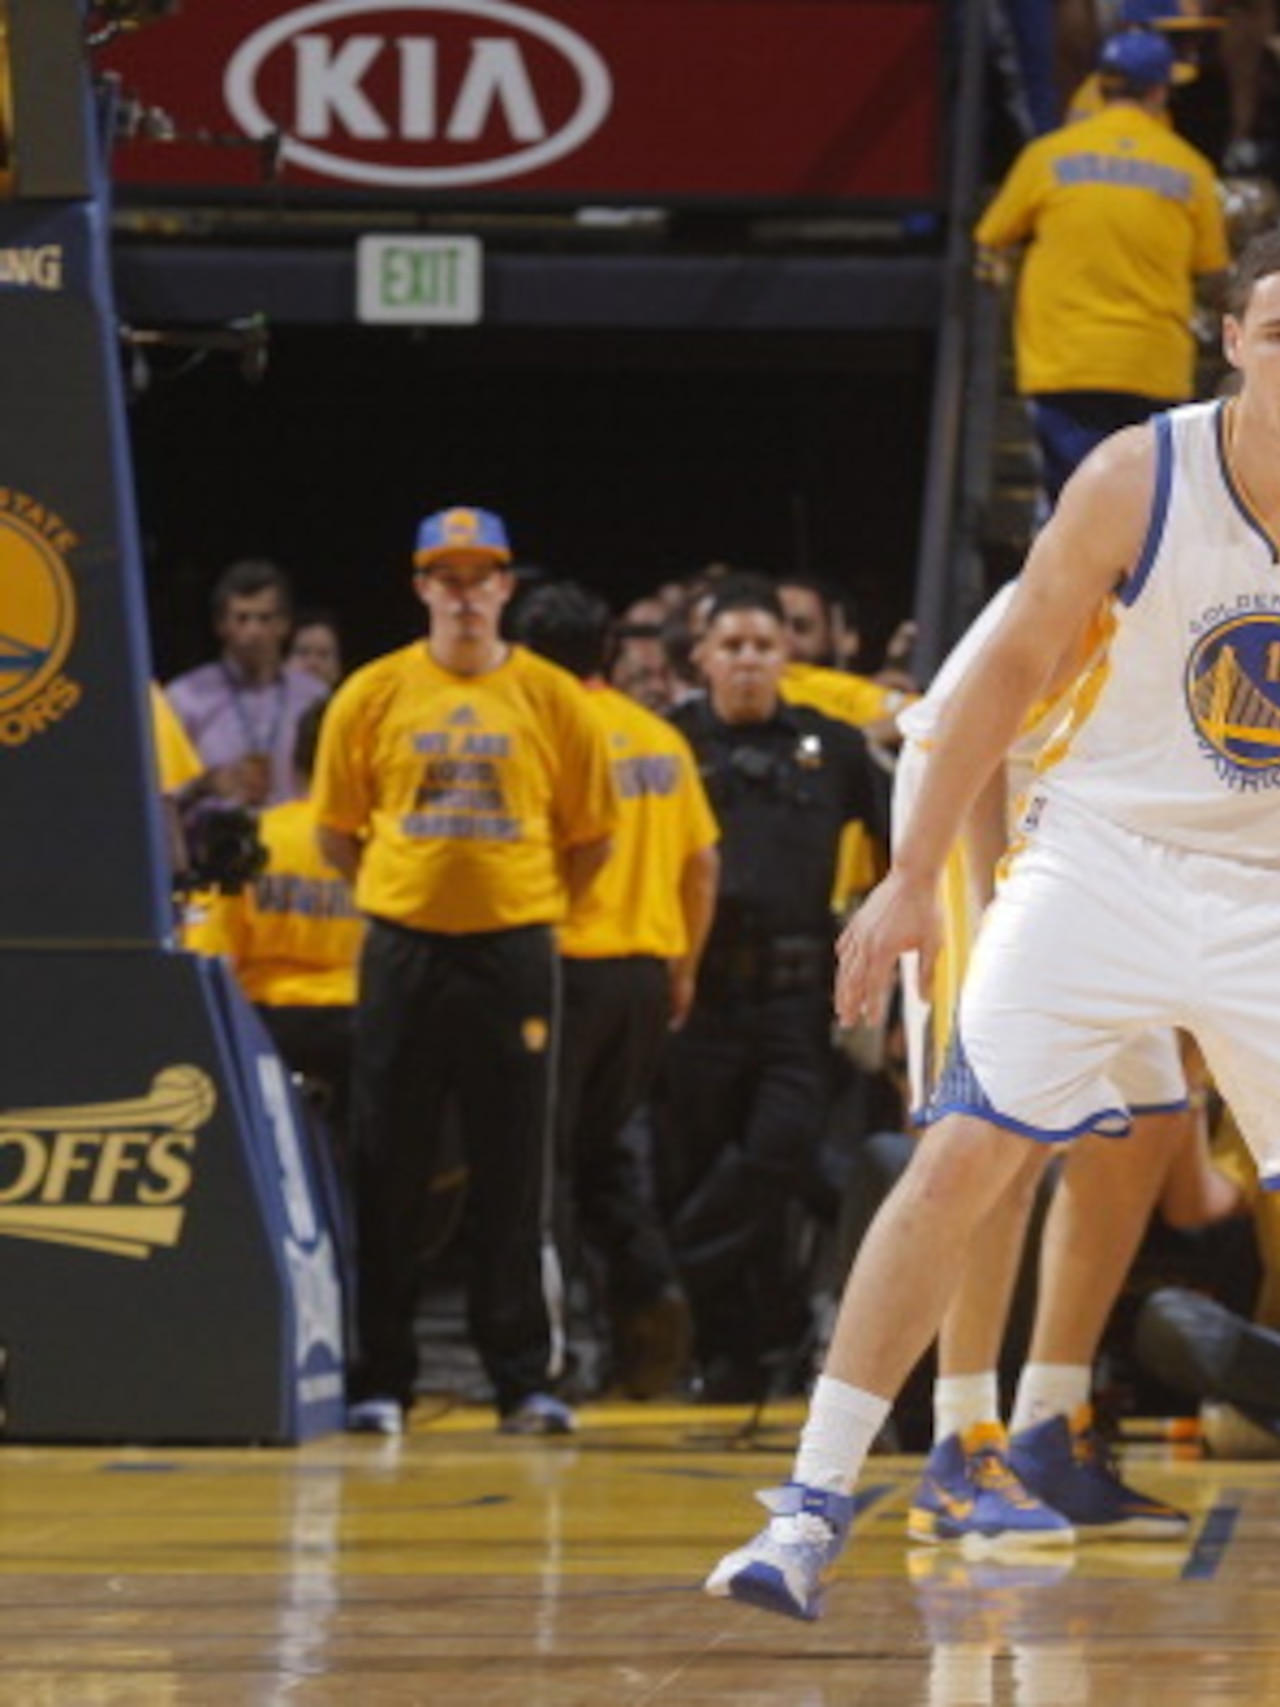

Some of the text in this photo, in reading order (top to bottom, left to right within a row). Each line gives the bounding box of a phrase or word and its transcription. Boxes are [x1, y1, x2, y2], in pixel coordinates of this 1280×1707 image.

[293, 34, 547, 142] KIA
[379, 246, 460, 307] EXIT
[0, 1130, 197, 1205] OFFS
